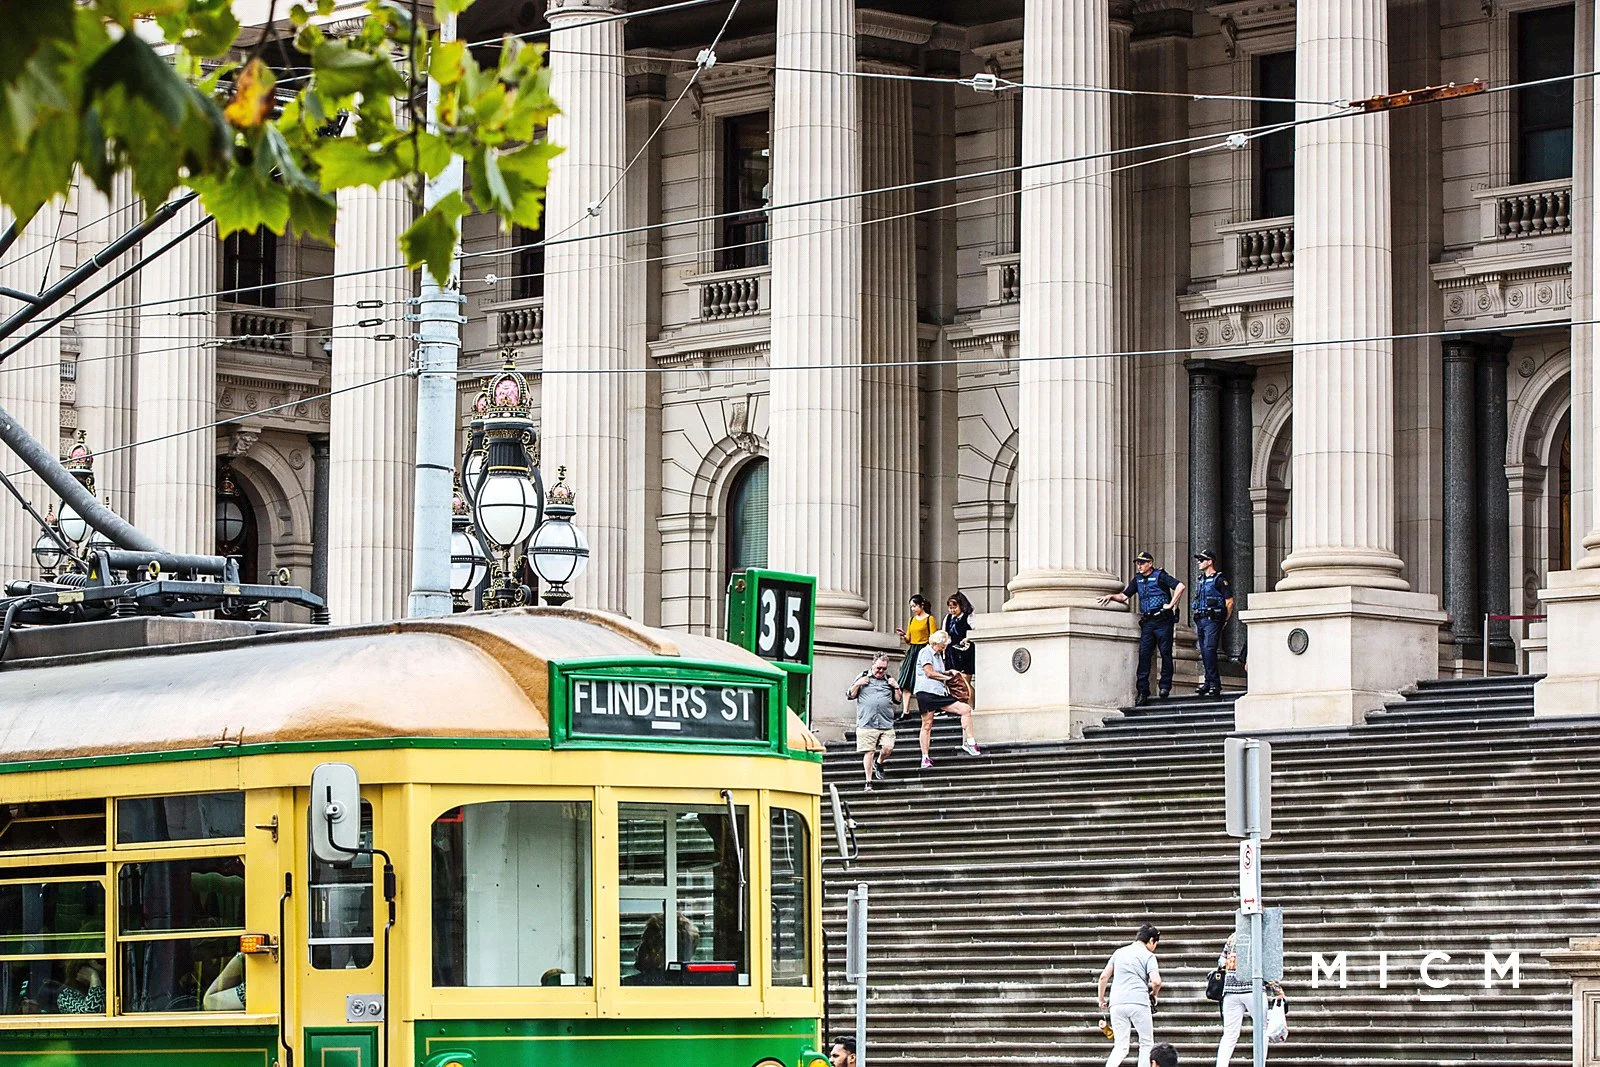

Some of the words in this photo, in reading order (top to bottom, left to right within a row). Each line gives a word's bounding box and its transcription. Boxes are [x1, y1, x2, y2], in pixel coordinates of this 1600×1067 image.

[758, 589, 801, 656] 35
[574, 680, 708, 719] FLINDERS
[720, 687, 754, 721] ST
